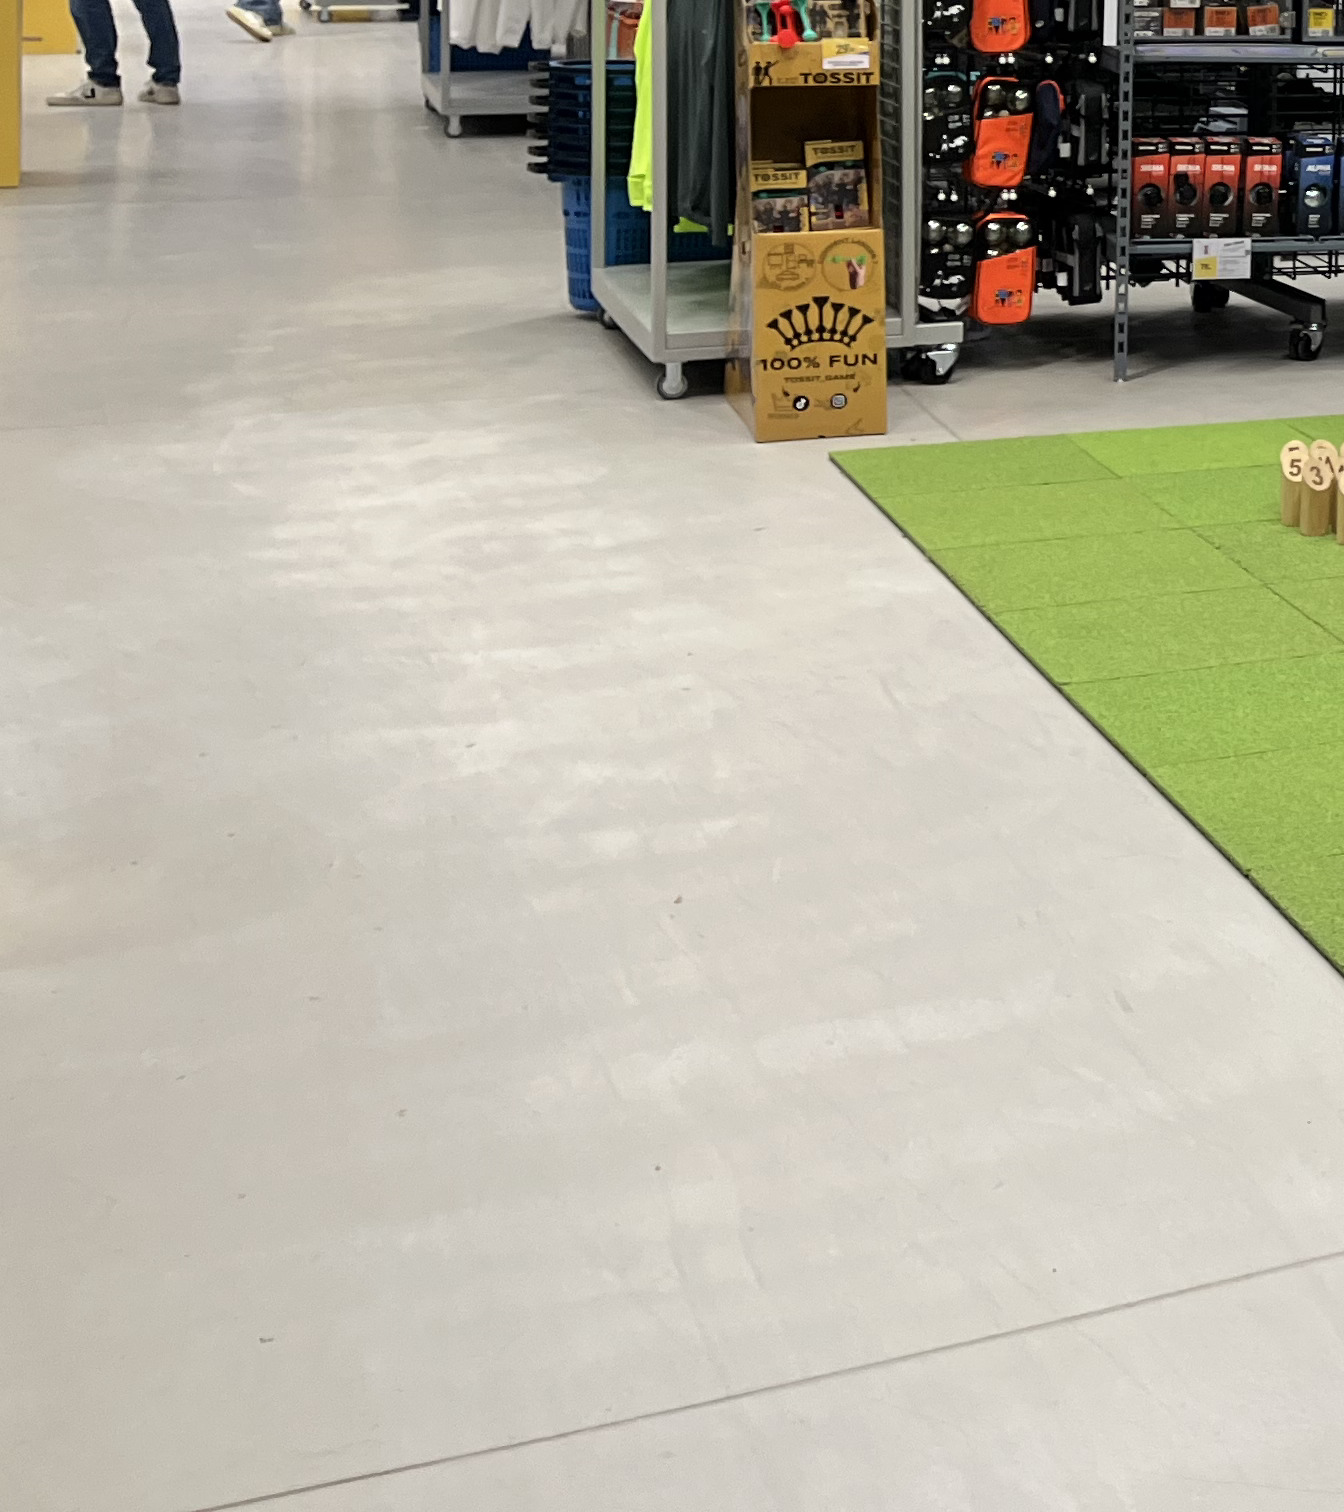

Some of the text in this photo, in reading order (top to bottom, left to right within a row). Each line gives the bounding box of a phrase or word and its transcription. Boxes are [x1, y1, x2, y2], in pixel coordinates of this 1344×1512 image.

[799, 72, 875, 85] TOSSIT
[812, 144, 857, 155] TOSSIT
[753, 172, 801, 182] TOSSIT
[757, 353, 878, 371] 100% FUN
[1289, 458, 1302, 476] 5
[1310, 466, 1324, 485] 3
